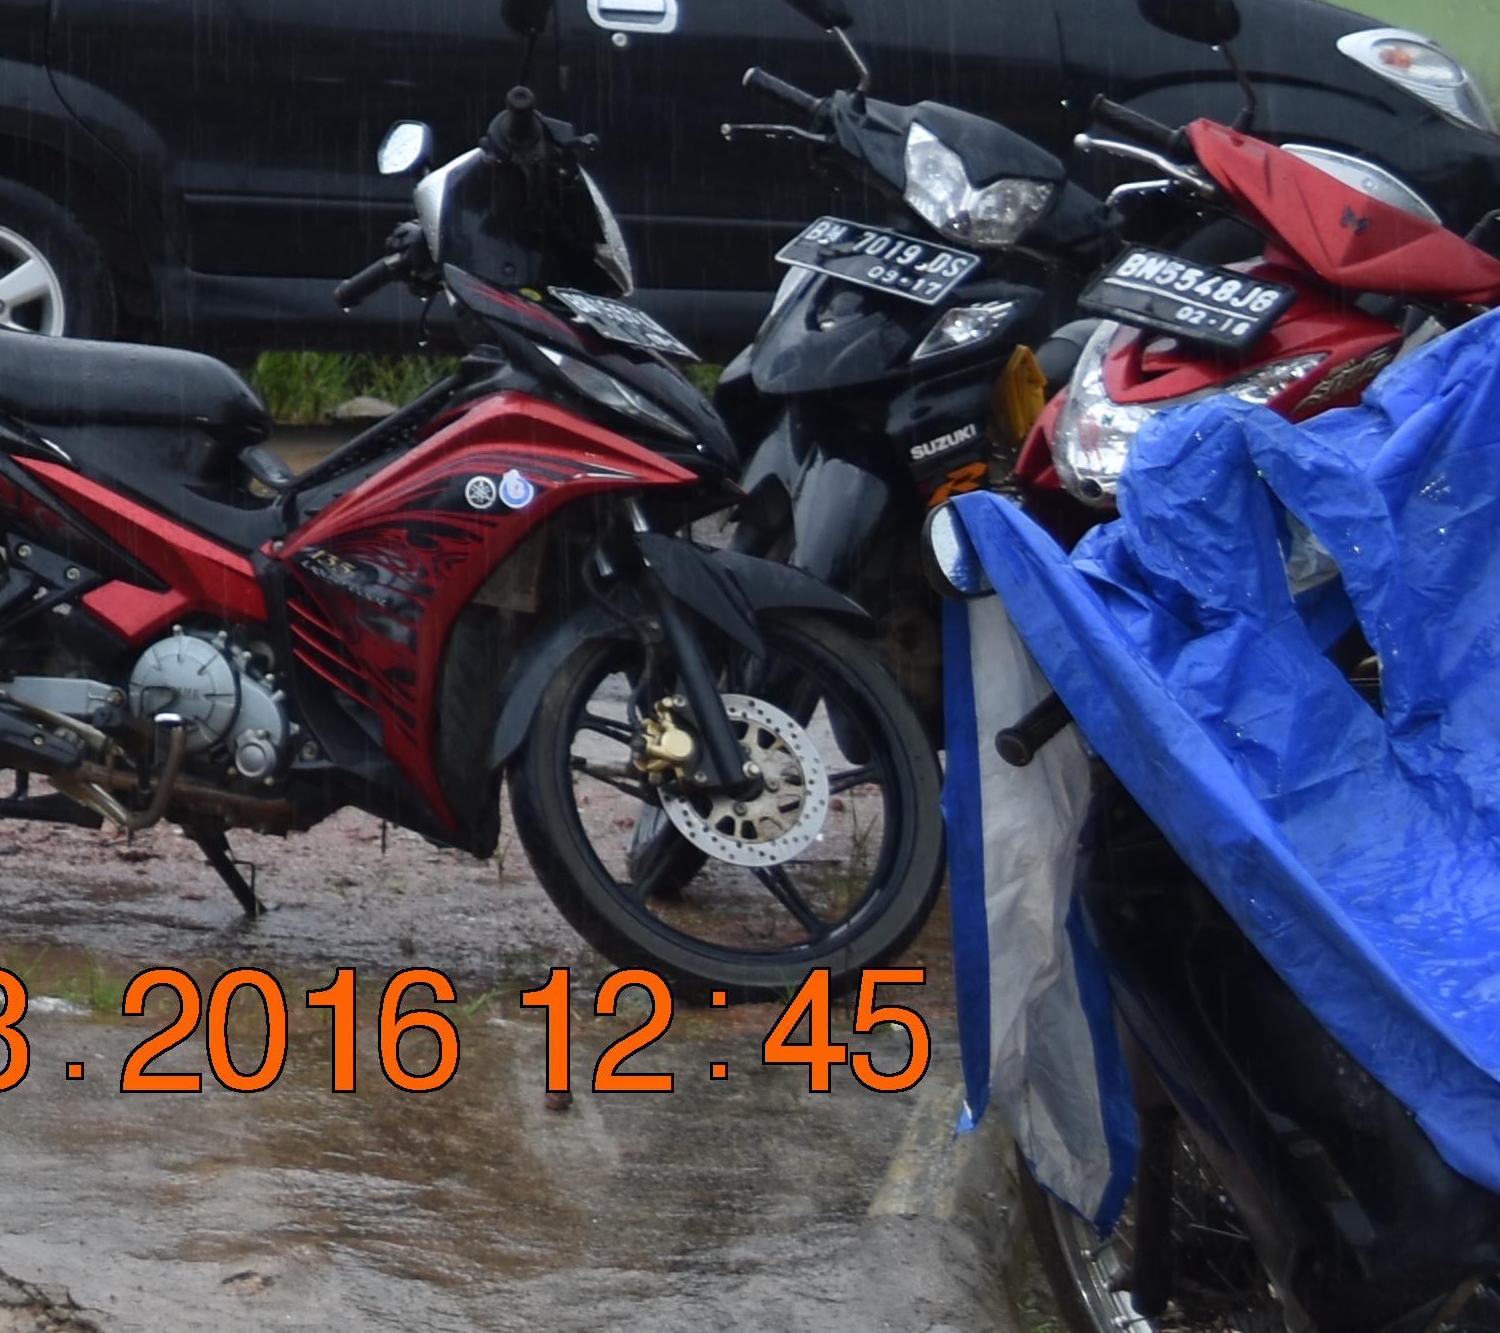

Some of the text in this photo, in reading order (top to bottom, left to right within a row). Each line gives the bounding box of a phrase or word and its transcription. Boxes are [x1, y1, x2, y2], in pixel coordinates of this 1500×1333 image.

[853, 231, 922, 265] 7019
[927, 252, 968, 277] DS
[909, 422, 977, 460] SUZUKI
